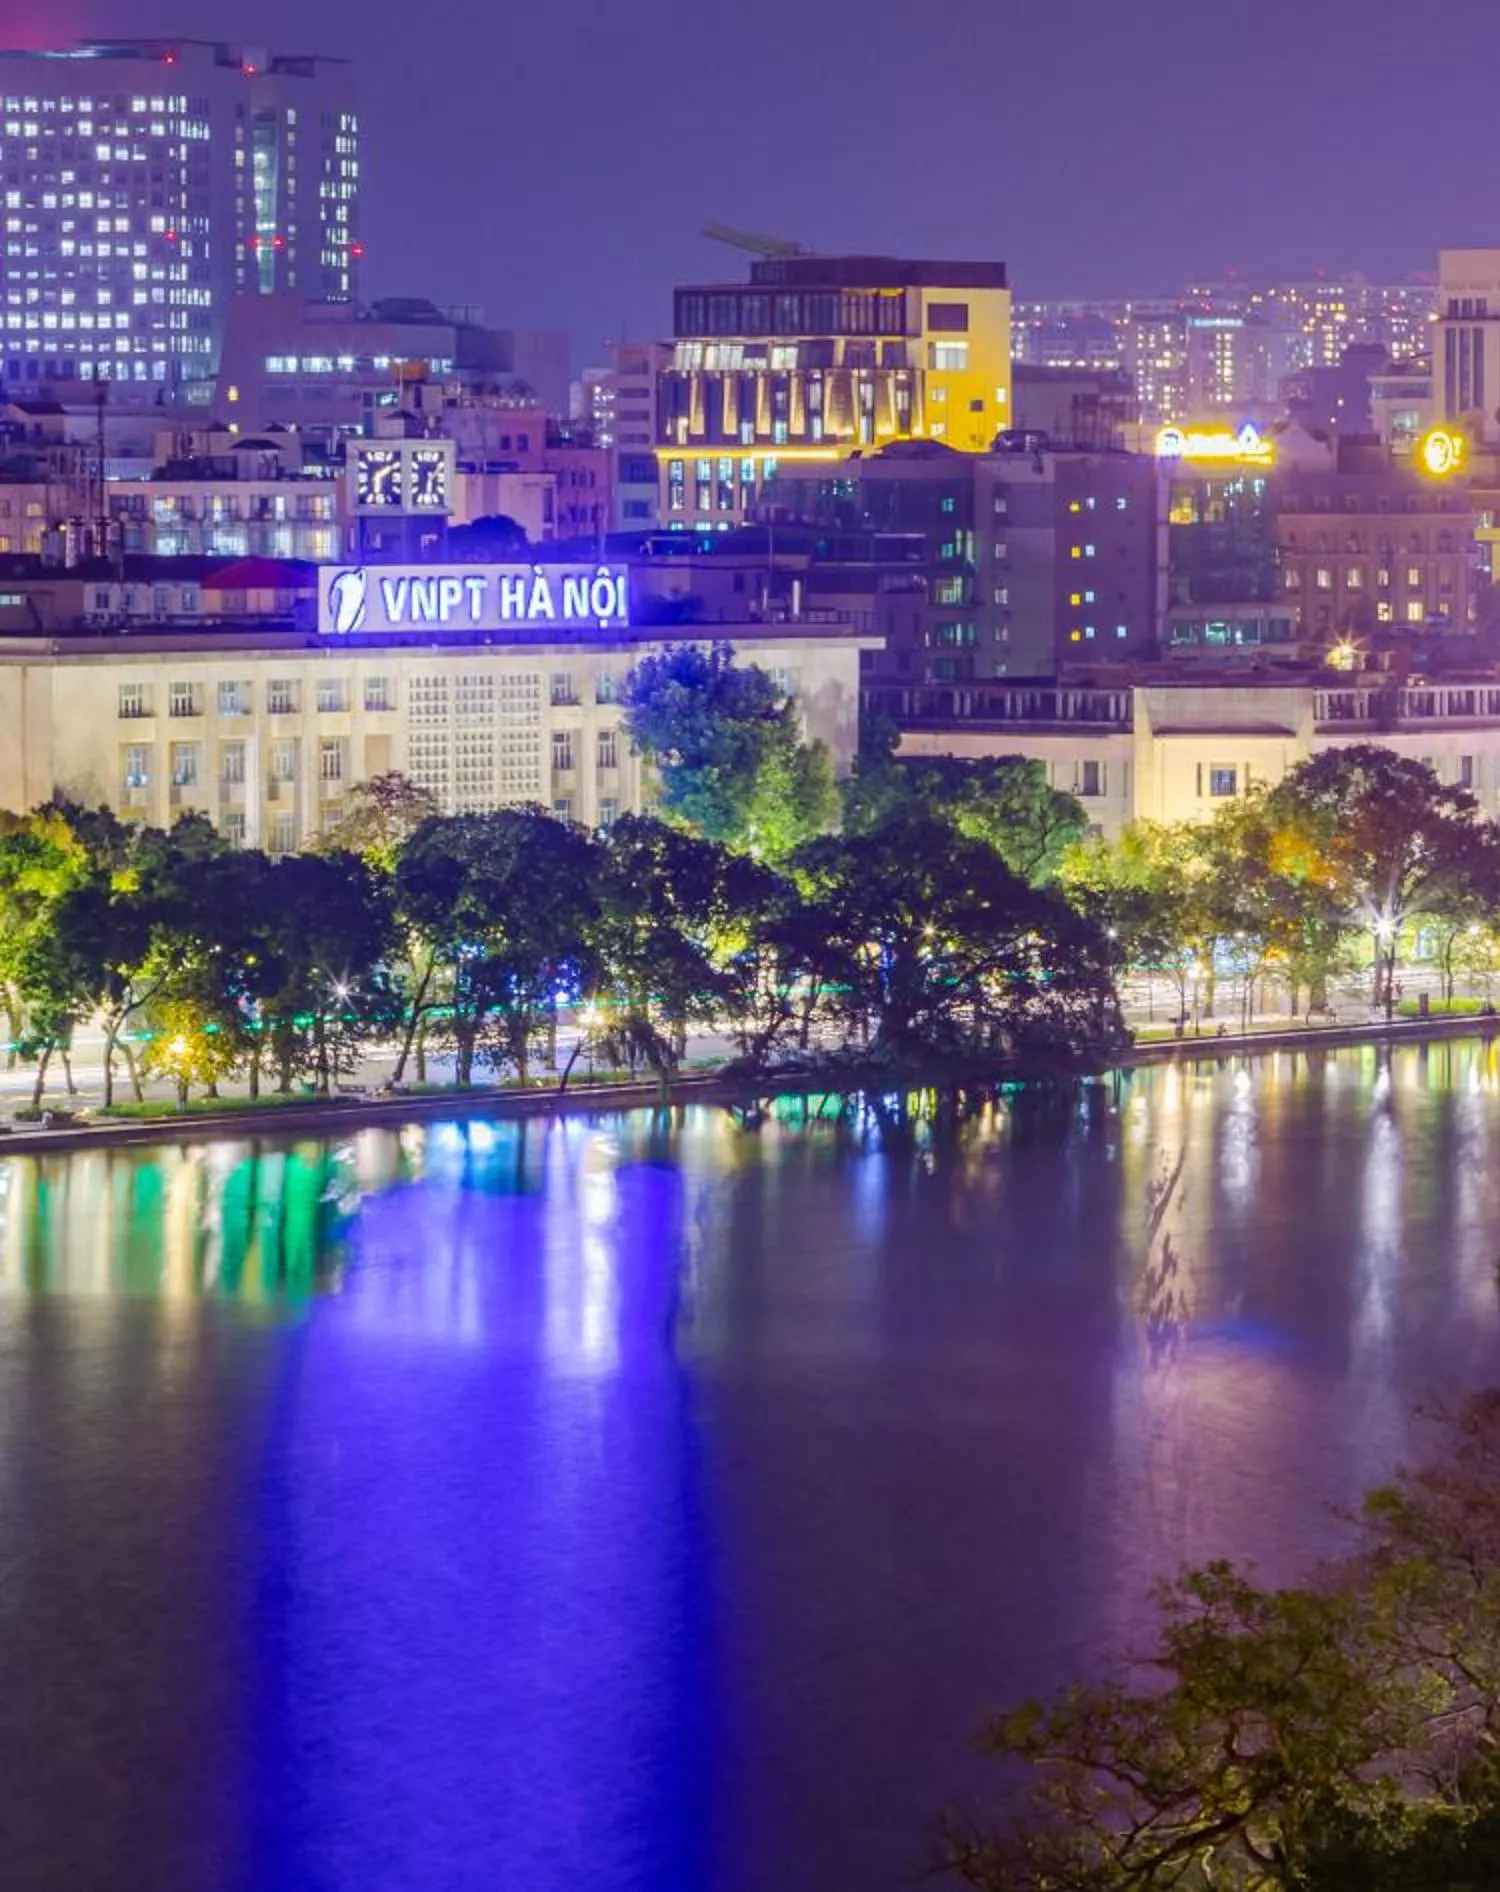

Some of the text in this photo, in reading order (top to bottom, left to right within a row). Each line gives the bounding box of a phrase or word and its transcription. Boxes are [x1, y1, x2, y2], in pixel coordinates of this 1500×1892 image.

[382, 565, 626, 628] VNPT HÀ NỘI
